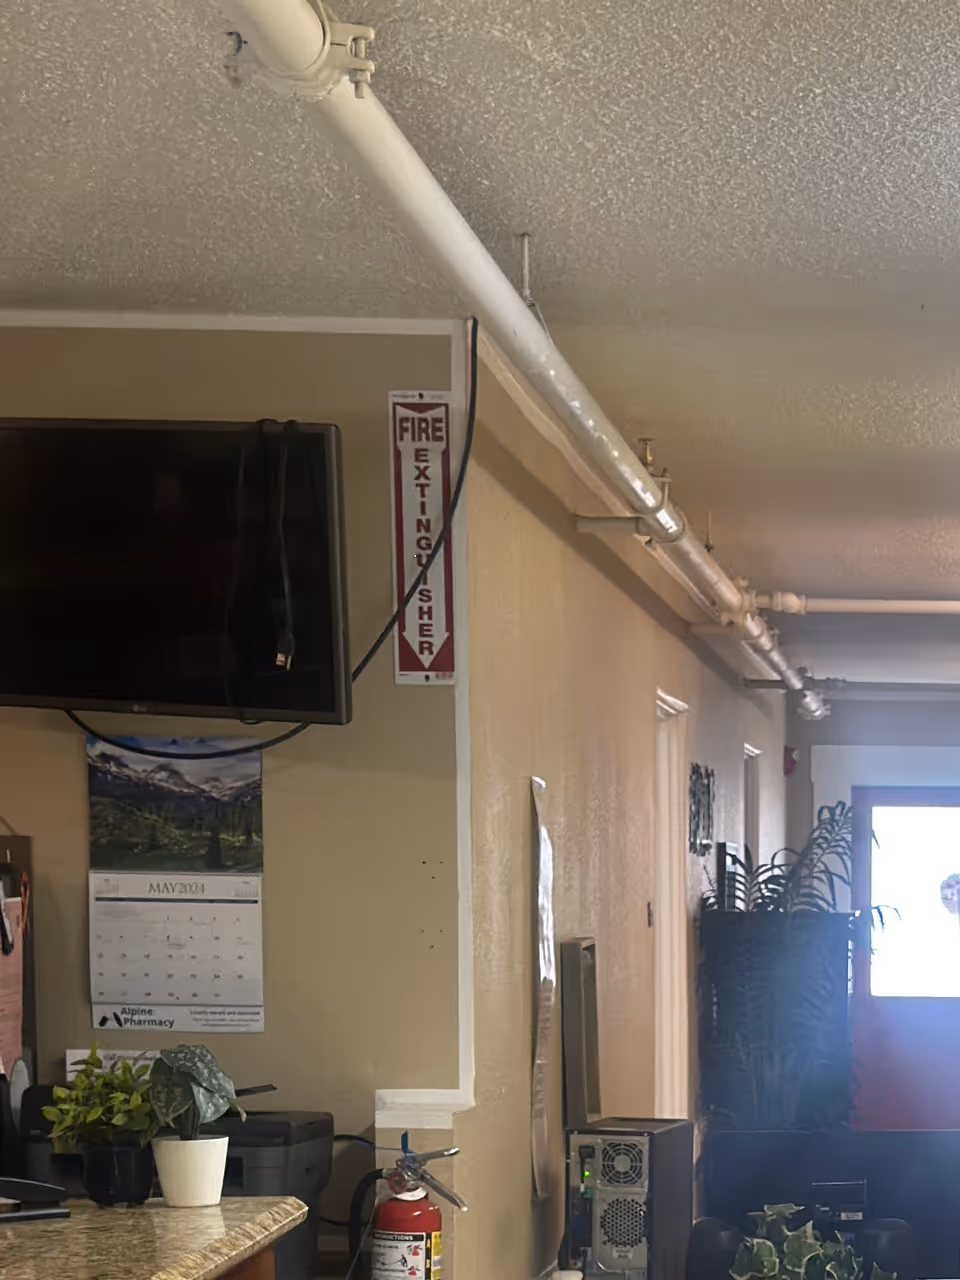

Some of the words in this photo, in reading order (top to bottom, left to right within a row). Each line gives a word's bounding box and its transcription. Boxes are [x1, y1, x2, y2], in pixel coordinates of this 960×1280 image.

[398, 416, 446, 442] FIRE
[413, 447, 435, 657] EXTINGUISHER
[120, 1007, 153, 1018] Alpine
[124, 1017, 175, 1028] Pharmacy
